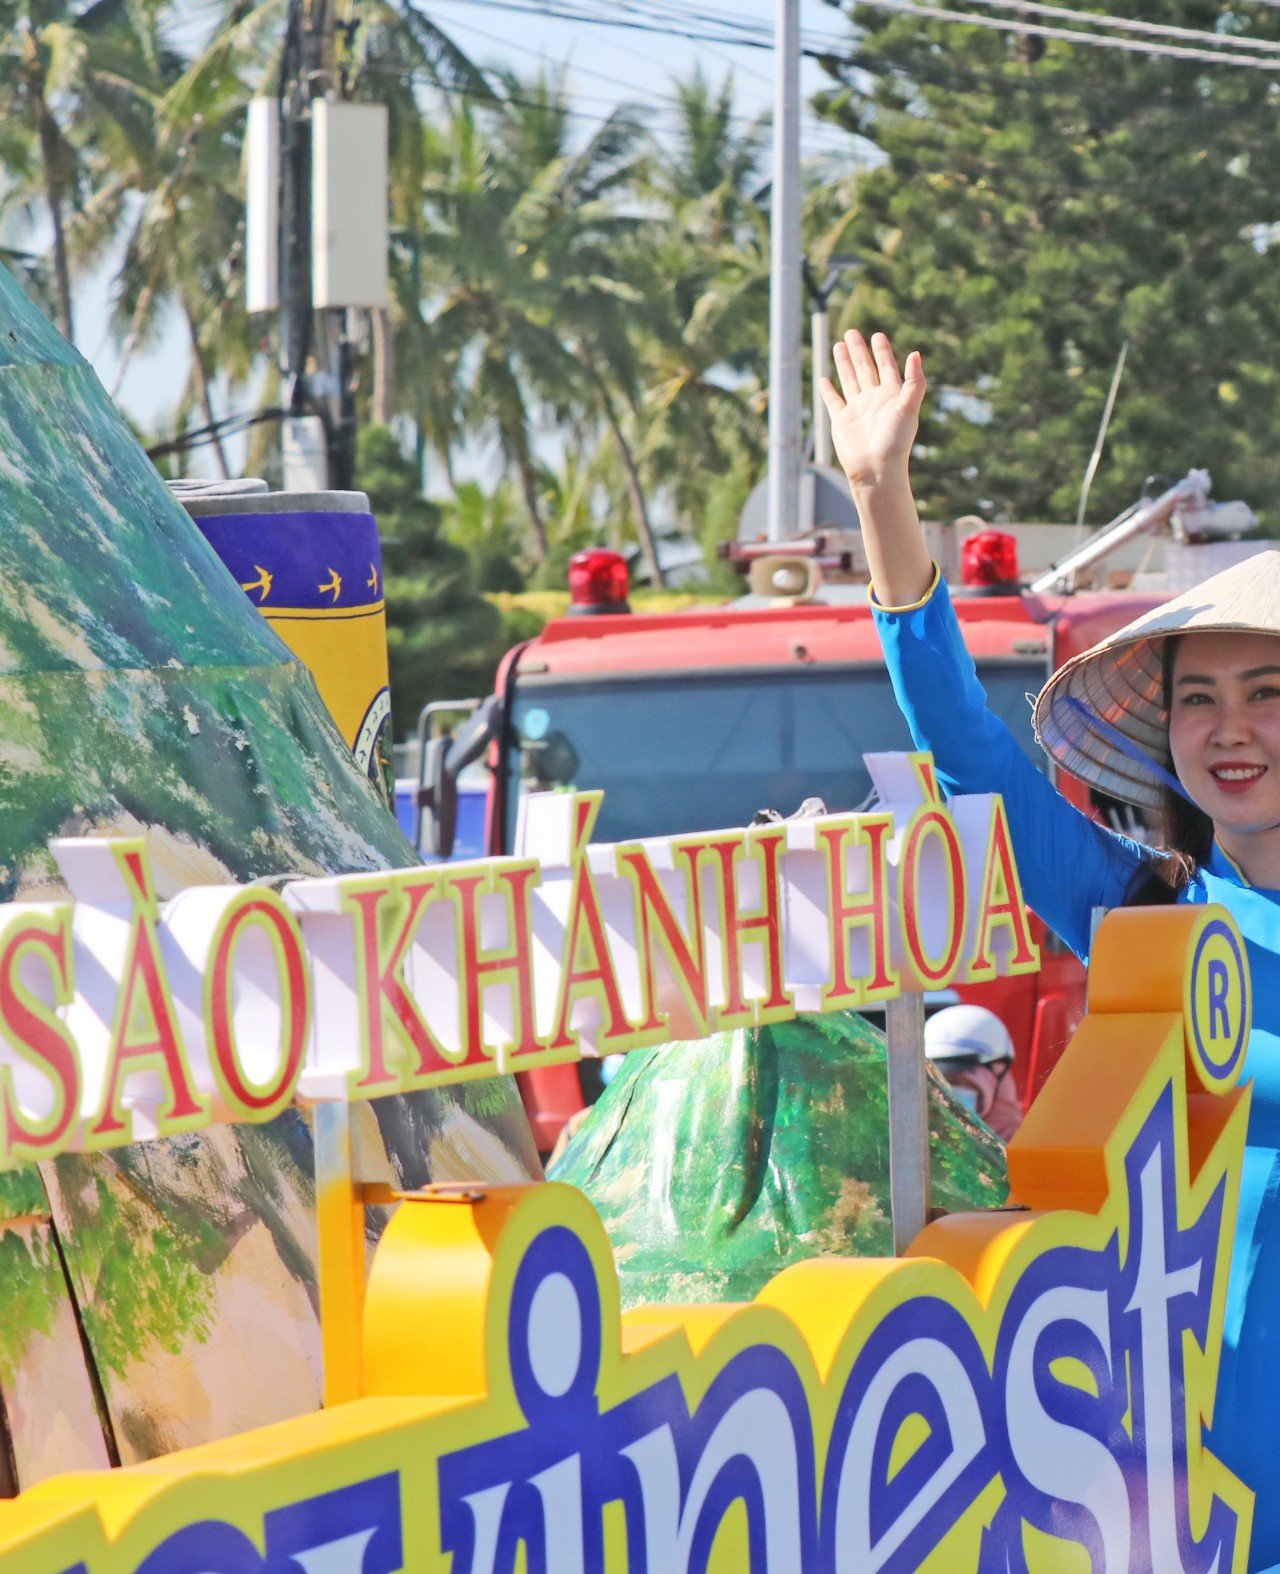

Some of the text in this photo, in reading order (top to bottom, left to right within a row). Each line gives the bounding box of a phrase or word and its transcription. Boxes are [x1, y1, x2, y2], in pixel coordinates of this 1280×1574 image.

[0, 761, 1038, 1152] SÀO KHÁNH HÒA
[55, 1078, 1240, 1574] inest
